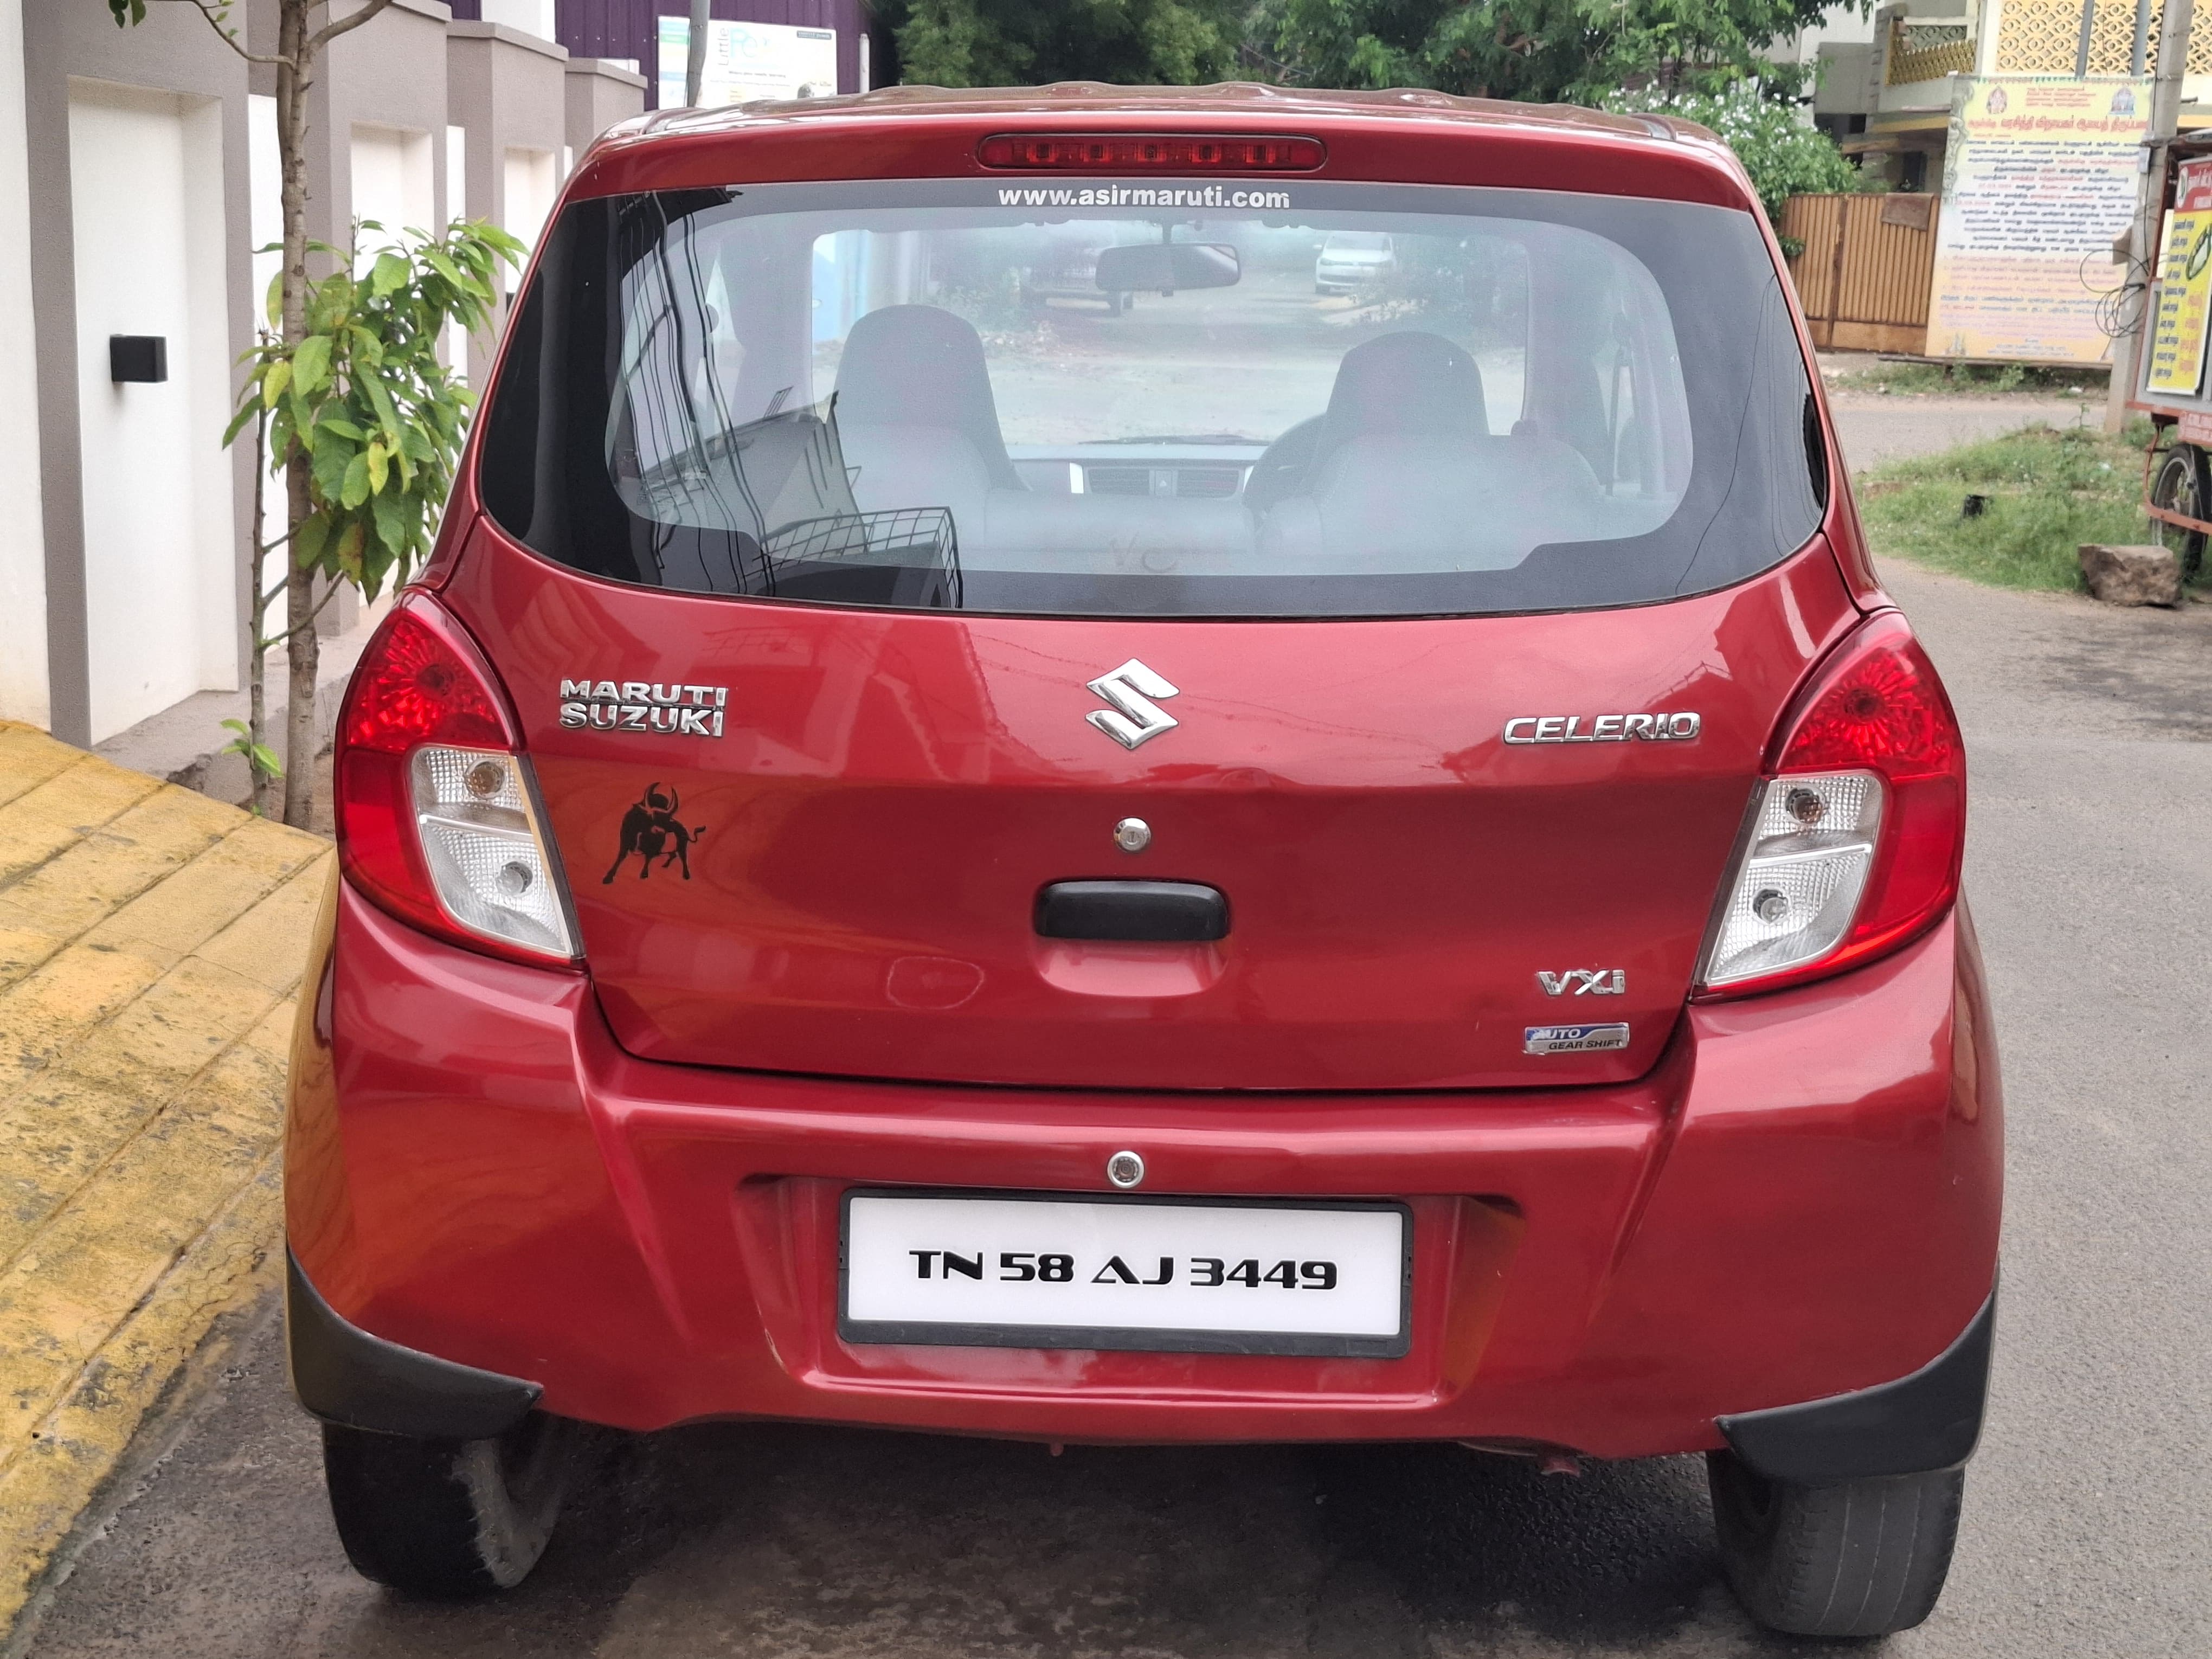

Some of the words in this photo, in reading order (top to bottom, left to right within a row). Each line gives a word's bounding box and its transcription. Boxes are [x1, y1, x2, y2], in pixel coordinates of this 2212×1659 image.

[998, 184, 1290, 208] www.asirmaruti.com
[560, 678, 729, 706] MARUTI
[559, 702, 724, 737] SUZUKI
[1503, 712, 1701, 744] CELERIO
[1531, 1028, 1581, 1040] AUTO
[1548, 1041, 1583, 1050] GEAR
[1586, 1039, 1623, 1049] SHIFT
[909, 1249, 983, 1281] TN
[999, 1252, 1075, 1283] 58
[1090, 1254, 1174, 1285] AJ
[1189, 1257, 1338, 1290] 3449
